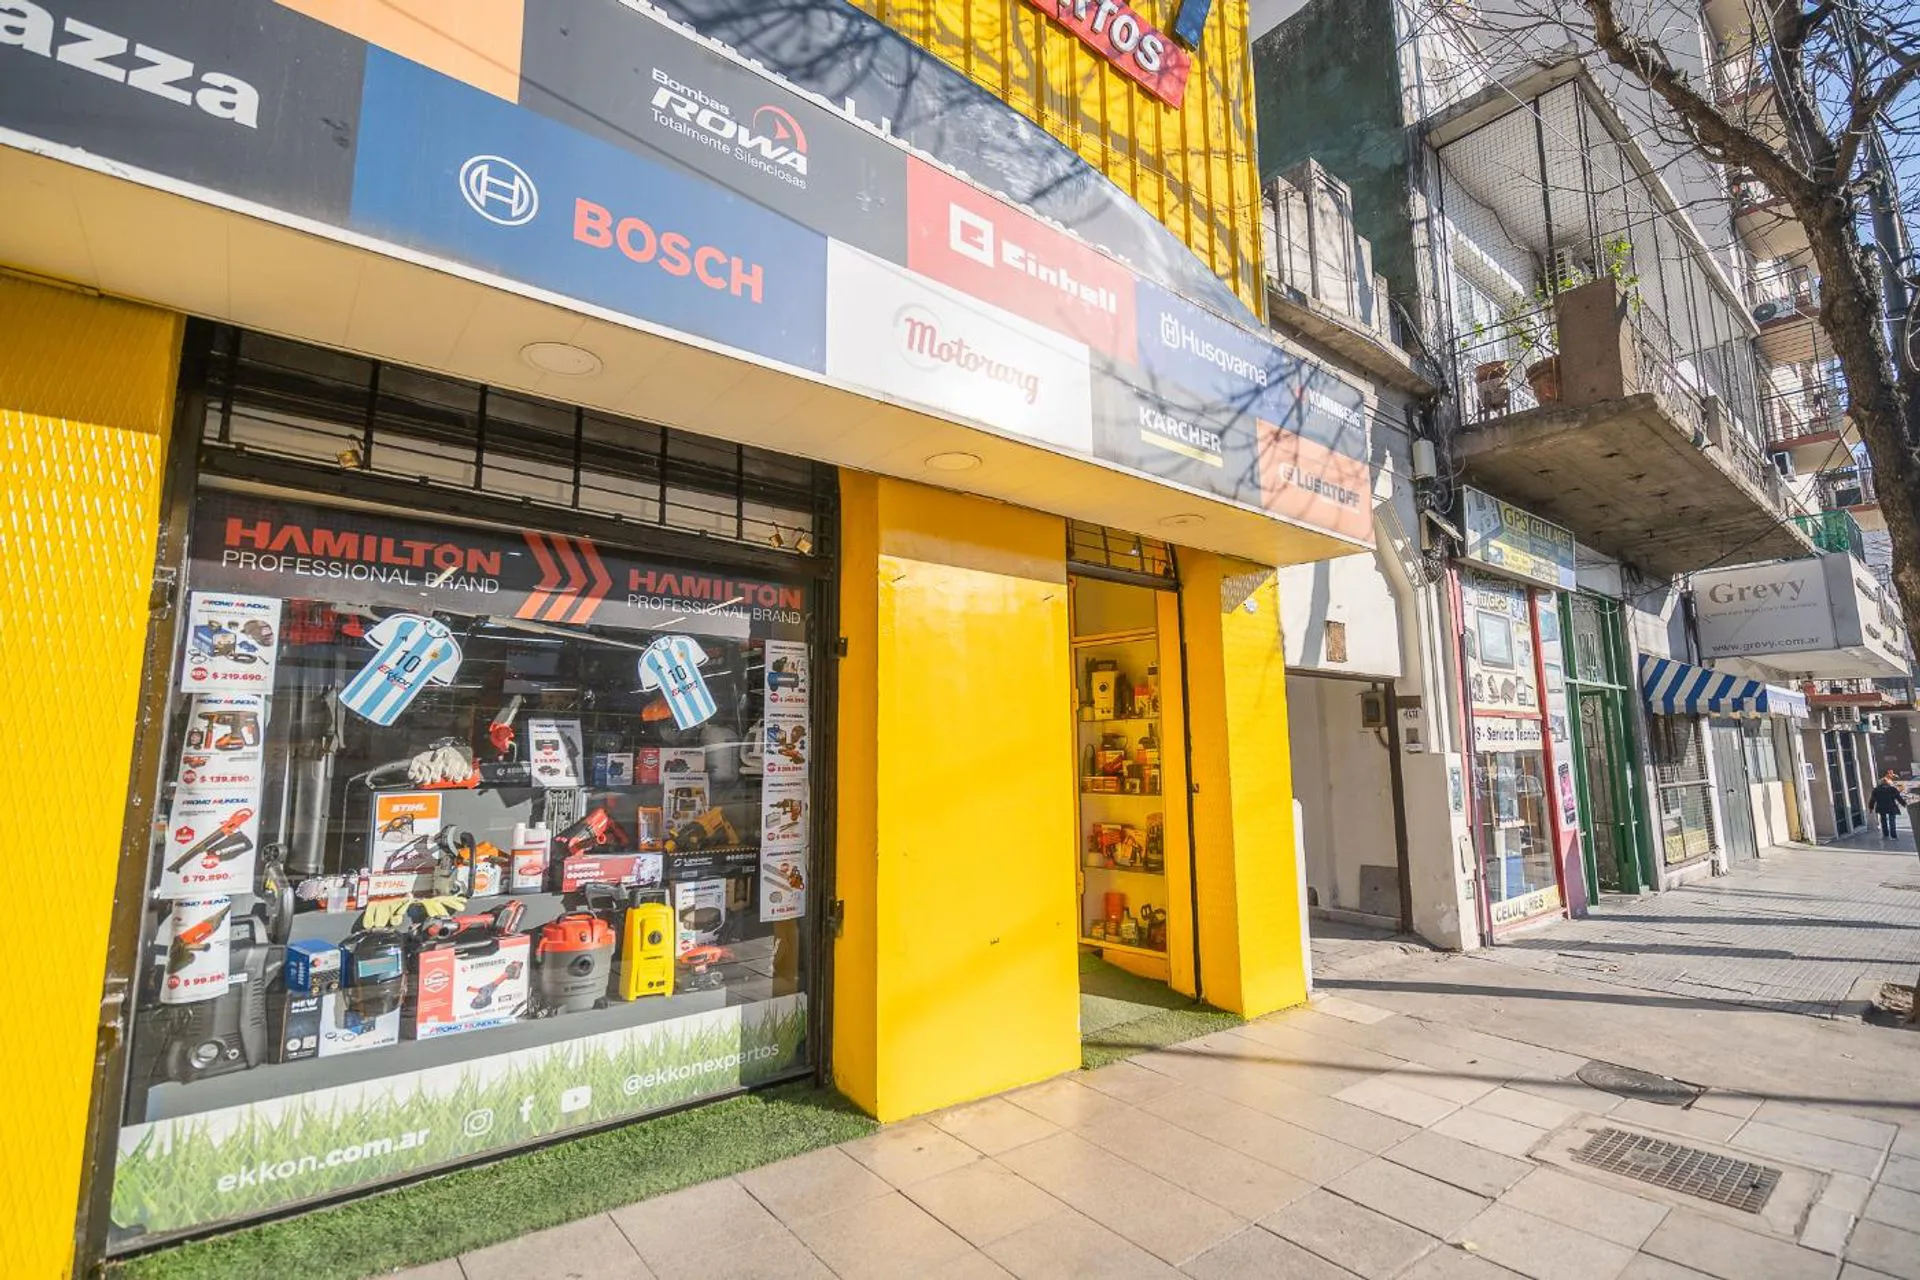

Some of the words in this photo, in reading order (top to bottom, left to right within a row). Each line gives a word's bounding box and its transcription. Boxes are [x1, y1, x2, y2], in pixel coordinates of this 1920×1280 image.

[651, 66, 731, 116] Bombas
[650, 86, 808, 176] ROWA
[651, 107, 731, 155] Totalmente
[734, 143, 807, 190] Silenciosas
[573, 197, 764, 304] BOSCH
[1001, 239, 1117, 314] Einhell
[905, 315, 1040, 405] Motorarg
[1181, 324, 1268, 387] Husqvarna
[221, 549, 417, 587] PROFESSIONAL
[424, 571, 499, 595] BRAND
[225, 517, 500, 575] HAMILTON
[627, 593, 749, 621] PROFESSIONAL
[752, 606, 801, 625] BRAND
[628, 568, 804, 610] HAMILTON
[1708, 579, 1806, 604] Grevy
[396, 649, 421, 673] 10
[668, 665, 687, 684] 10
[622, 1042, 781, 1097] @ekkonexpertos
[216, 1127, 430, 1193] ekkon.com.ar
